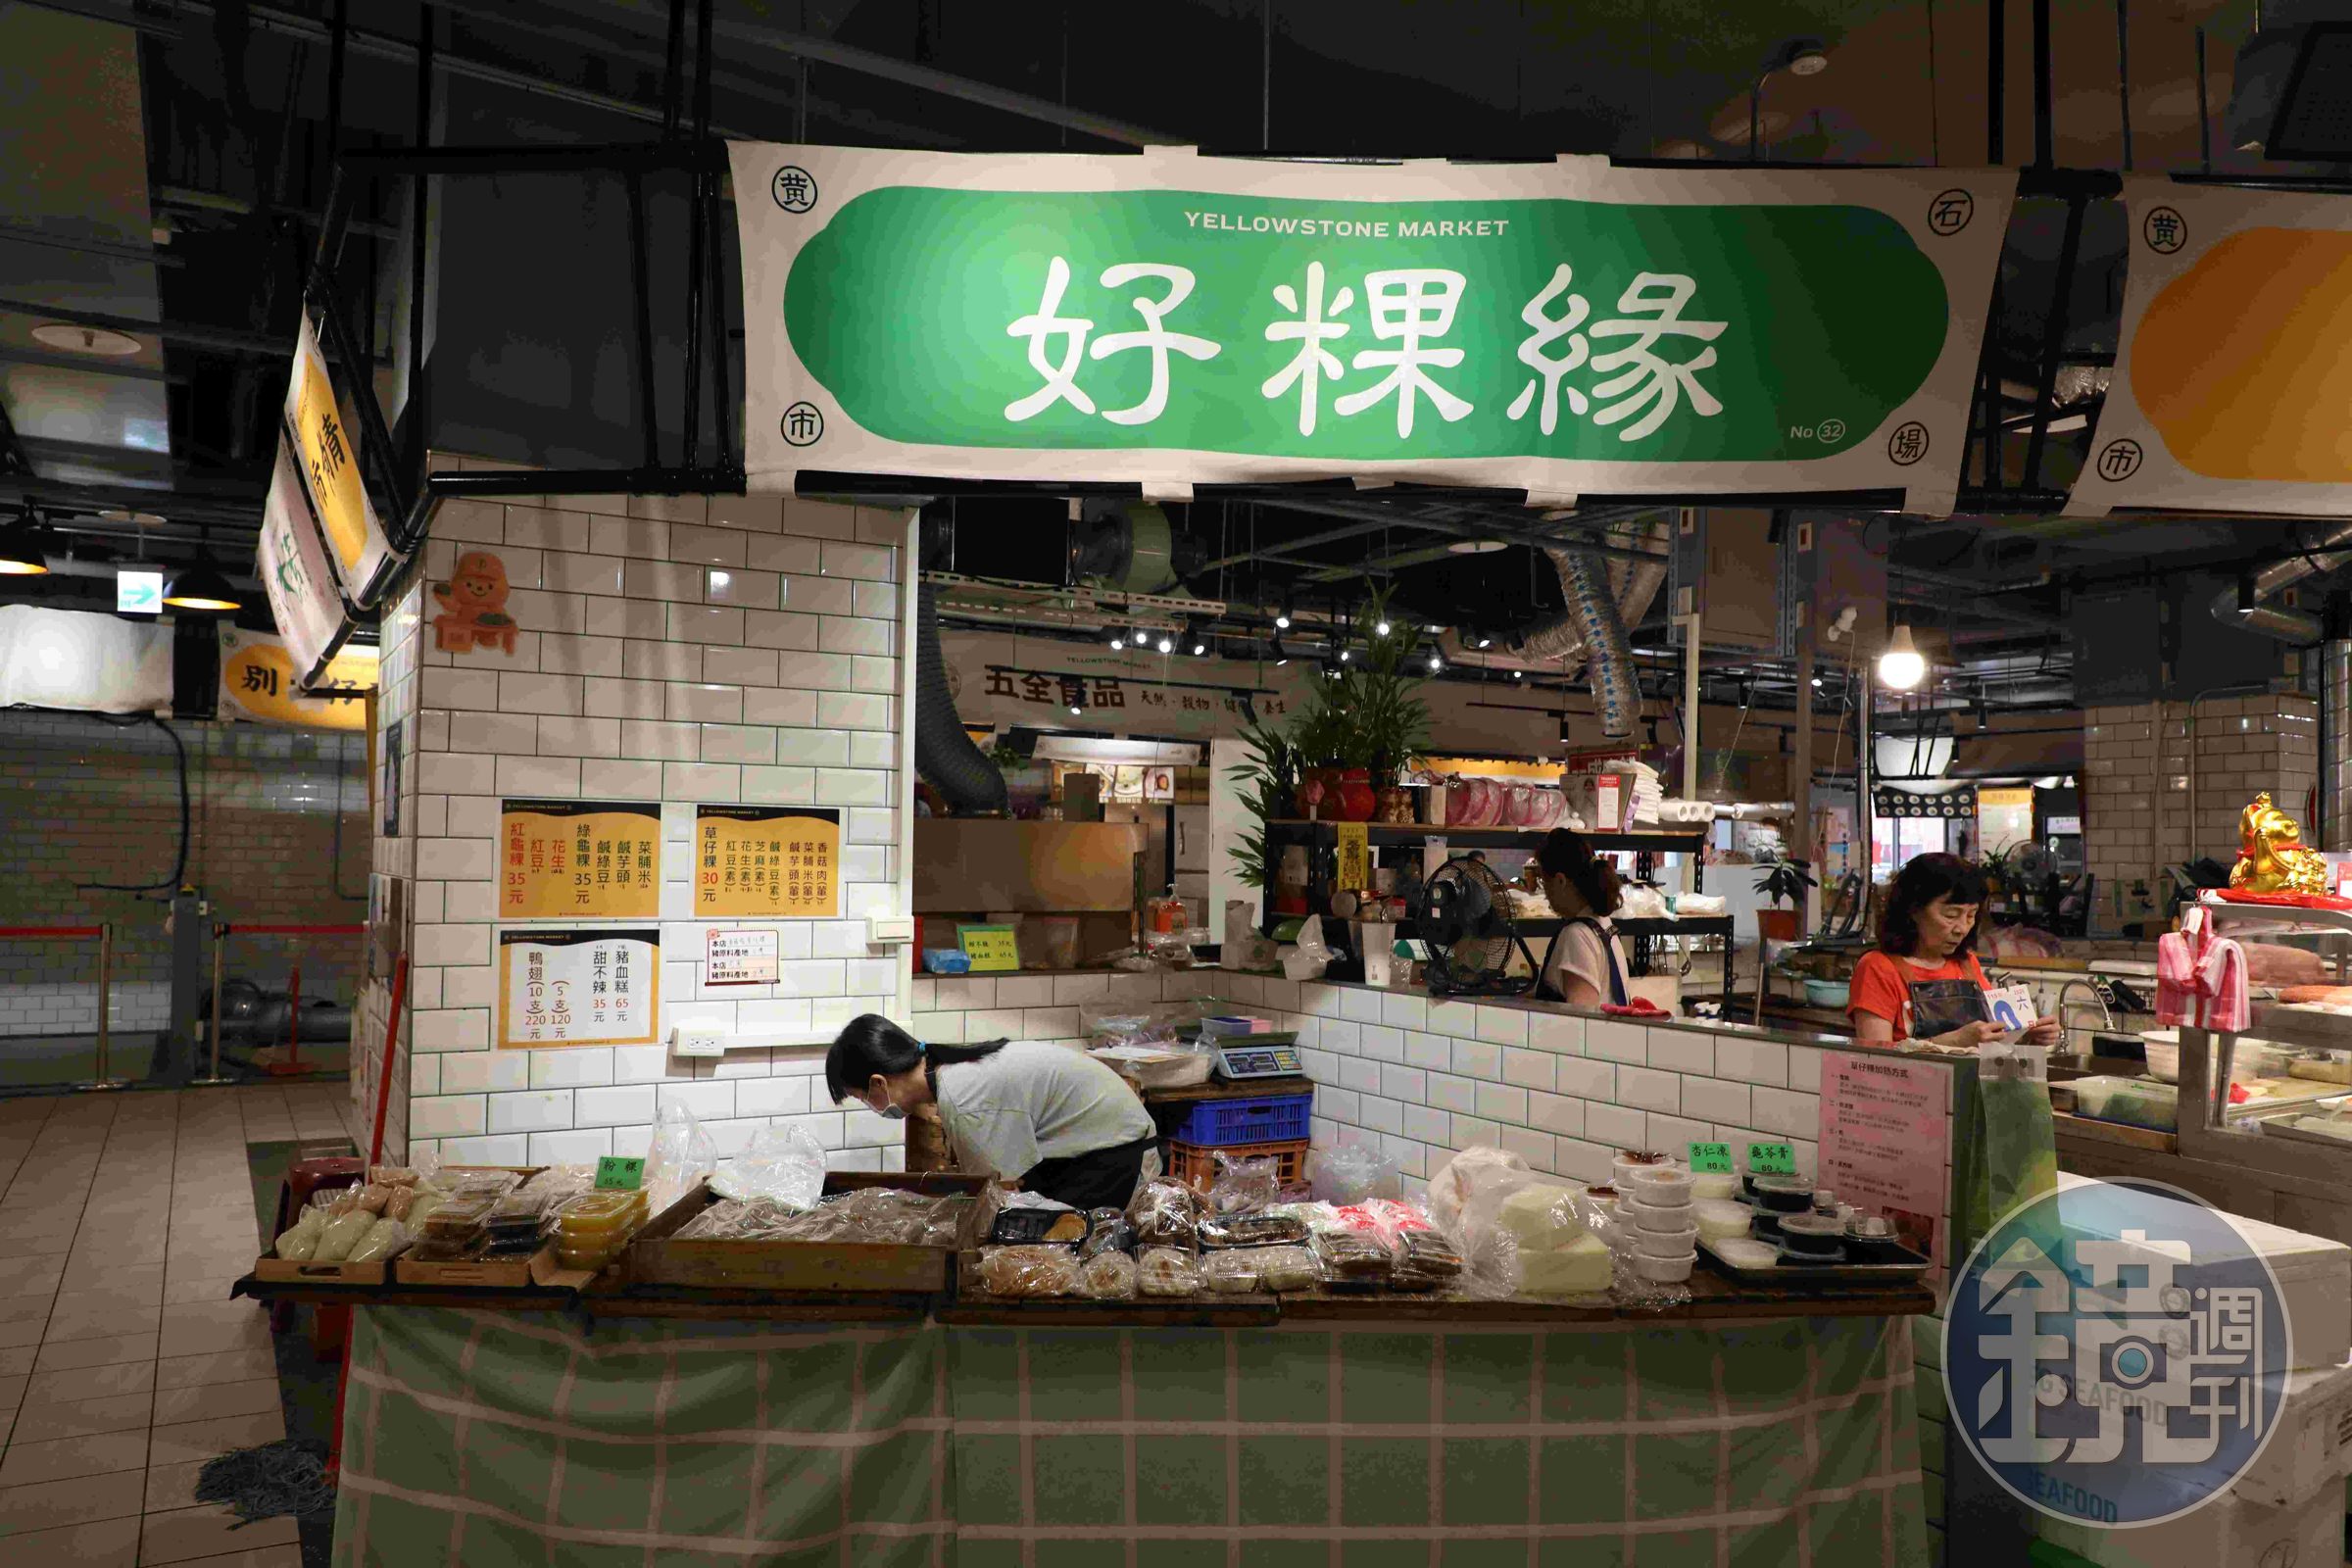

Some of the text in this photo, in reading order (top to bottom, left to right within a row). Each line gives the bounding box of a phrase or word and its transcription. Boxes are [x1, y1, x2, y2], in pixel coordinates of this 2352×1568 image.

[1184, 210, 1509, 238] YELLOWSTONE MARKET
[1003, 255, 1729, 442] 好粿緣
[1790, 425, 1814, 439] No
[530, 839, 545, 868] 紅豆
[551, 840, 566, 868] 花生
[2017, 996, 2029, 1010] 六
